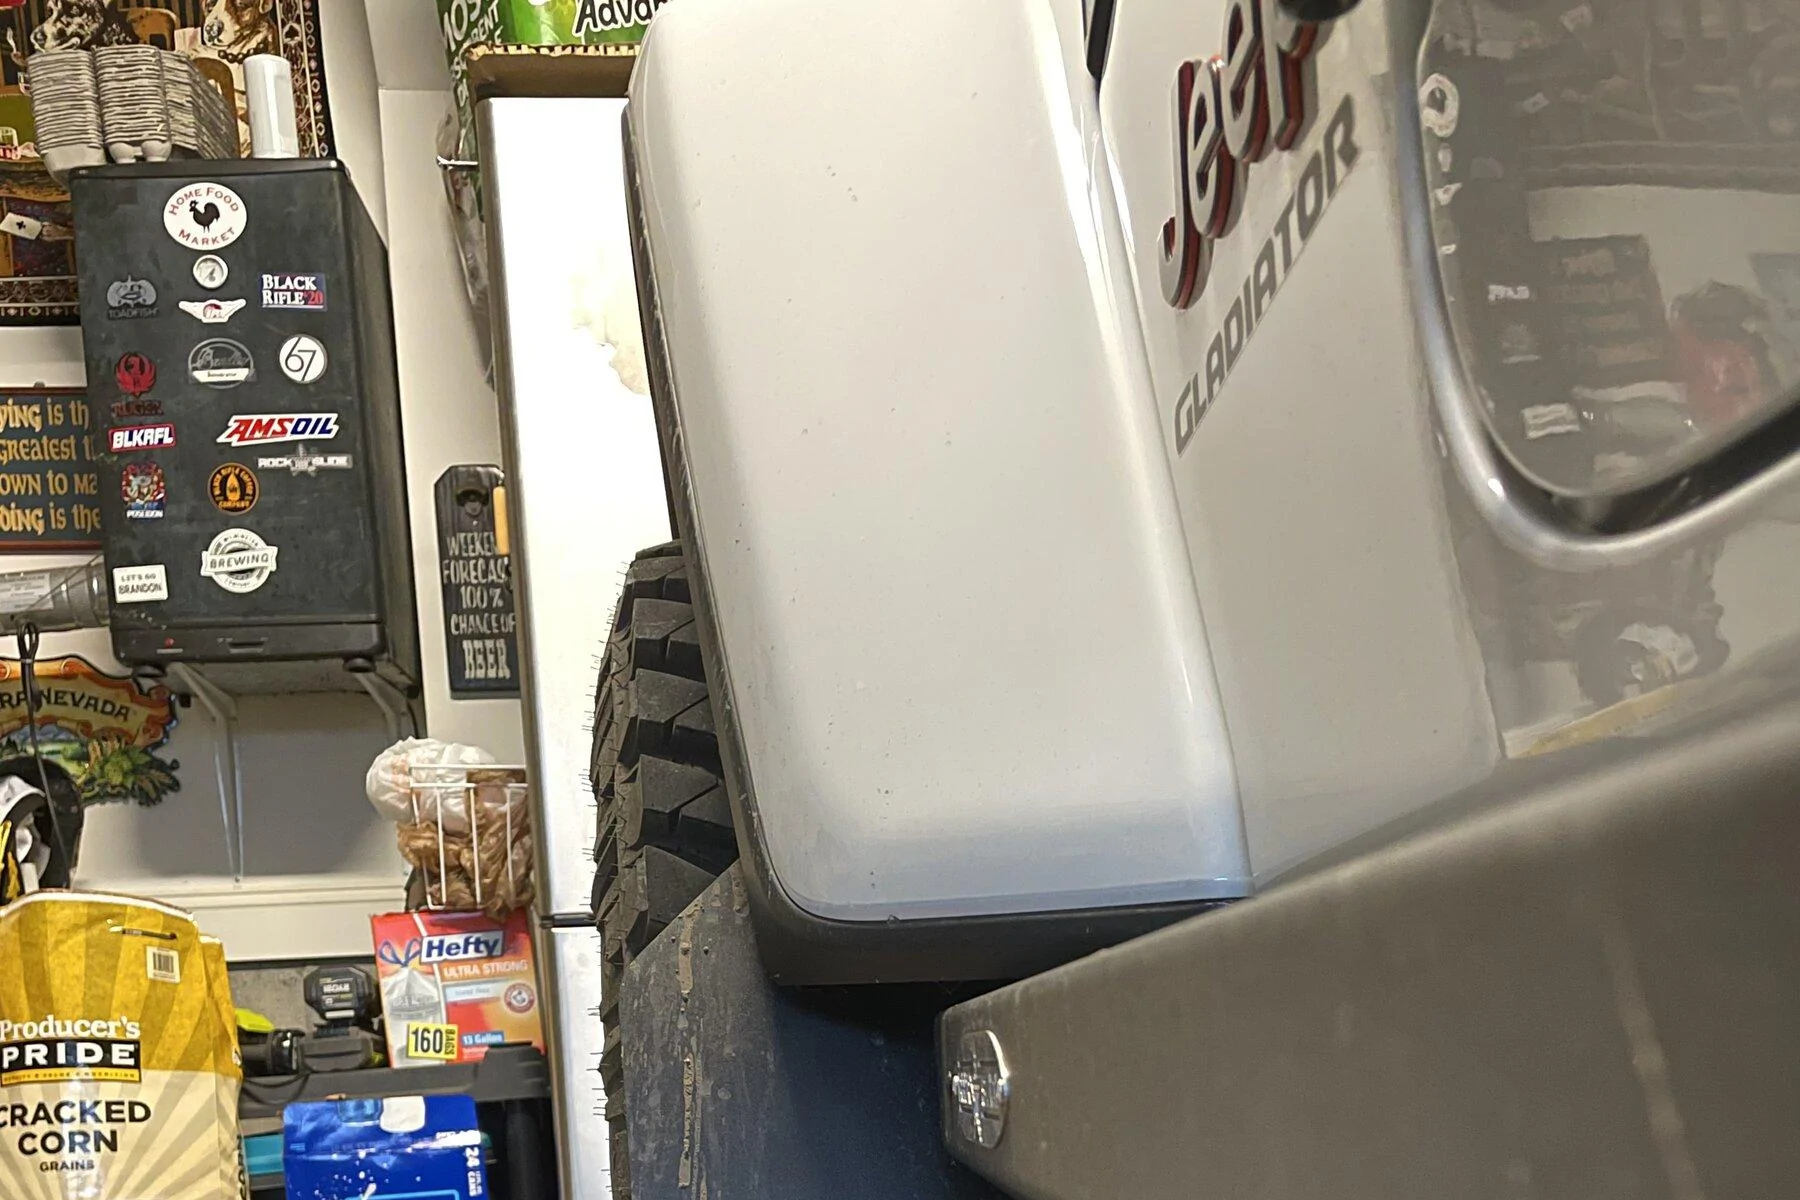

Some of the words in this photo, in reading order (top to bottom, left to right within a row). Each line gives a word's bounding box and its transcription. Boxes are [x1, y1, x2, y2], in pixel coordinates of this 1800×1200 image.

[168, 188, 202, 216] HOME
[206, 187, 240, 212] FOOD
[178, 226, 235, 246] MARKET
[262, 274, 317, 290] BLACK
[1174, 94, 1359, 457] GLADIATOR
[262, 290, 304, 305] RIFLE
[285, 337, 317, 382] 67
[47, 397, 63, 426] is
[226, 417, 334, 442] AMSOIL
[258, 457, 292, 468] ROCK
[311, 456, 349, 467] SLIDE
[49, 501, 66, 530] is
[71, 503, 101, 534] the
[210, 553, 269, 569] BREWING
[442, 556, 509, 585] FORECAS
[118, 583, 162, 594] BRANDON
[450, 613, 499, 635] CHANCE
[500, 613, 516, 634] OF
[462, 638, 511, 679] BEER
[41, 686, 130, 722] NEVADA
[425, 935, 500, 958] Hefty
[443, 964, 480, 979] ULTRA
[483, 960, 529, 975] STRONG
[0, 1014, 140, 1041] Producer's
[412, 1027, 443, 1054] 160
[445, 1028, 456, 1056] BAGS
[2, 1042, 136, 1069] PRIDE
[18, 1130, 118, 1156] CORN
[39, 1160, 94, 1172] GRAINS
[465, 1146, 480, 1168] 24
